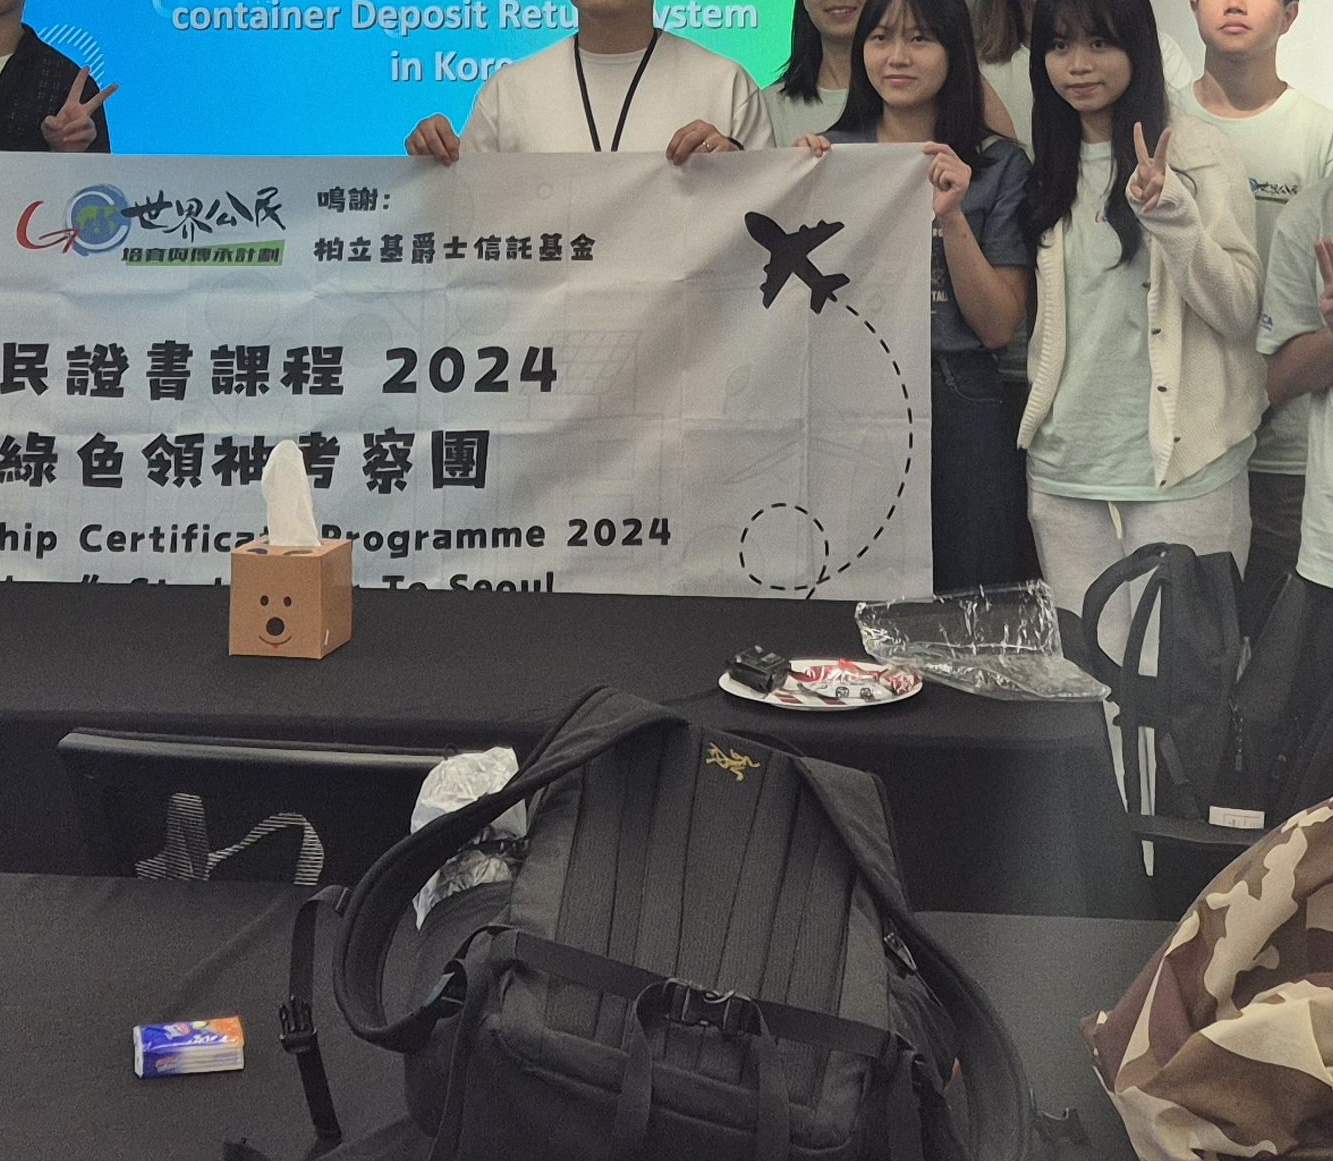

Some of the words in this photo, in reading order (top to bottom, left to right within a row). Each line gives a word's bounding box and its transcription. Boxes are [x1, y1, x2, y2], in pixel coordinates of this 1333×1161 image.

[172, 0, 341, 30] container
[653, 0, 758, 30] ystem
[391, 51, 423, 81] in
[435, 51, 514, 81] Kor
[122, 186, 287, 244] 世界公民
[313, 231, 596, 265] 柏立基爵士信託基金
[382, 345, 558, 394] 2024
[79, 522, 270, 553] Certifica
[320, 523, 546, 562] Programme
[567, 517, 671, 547] 2024
